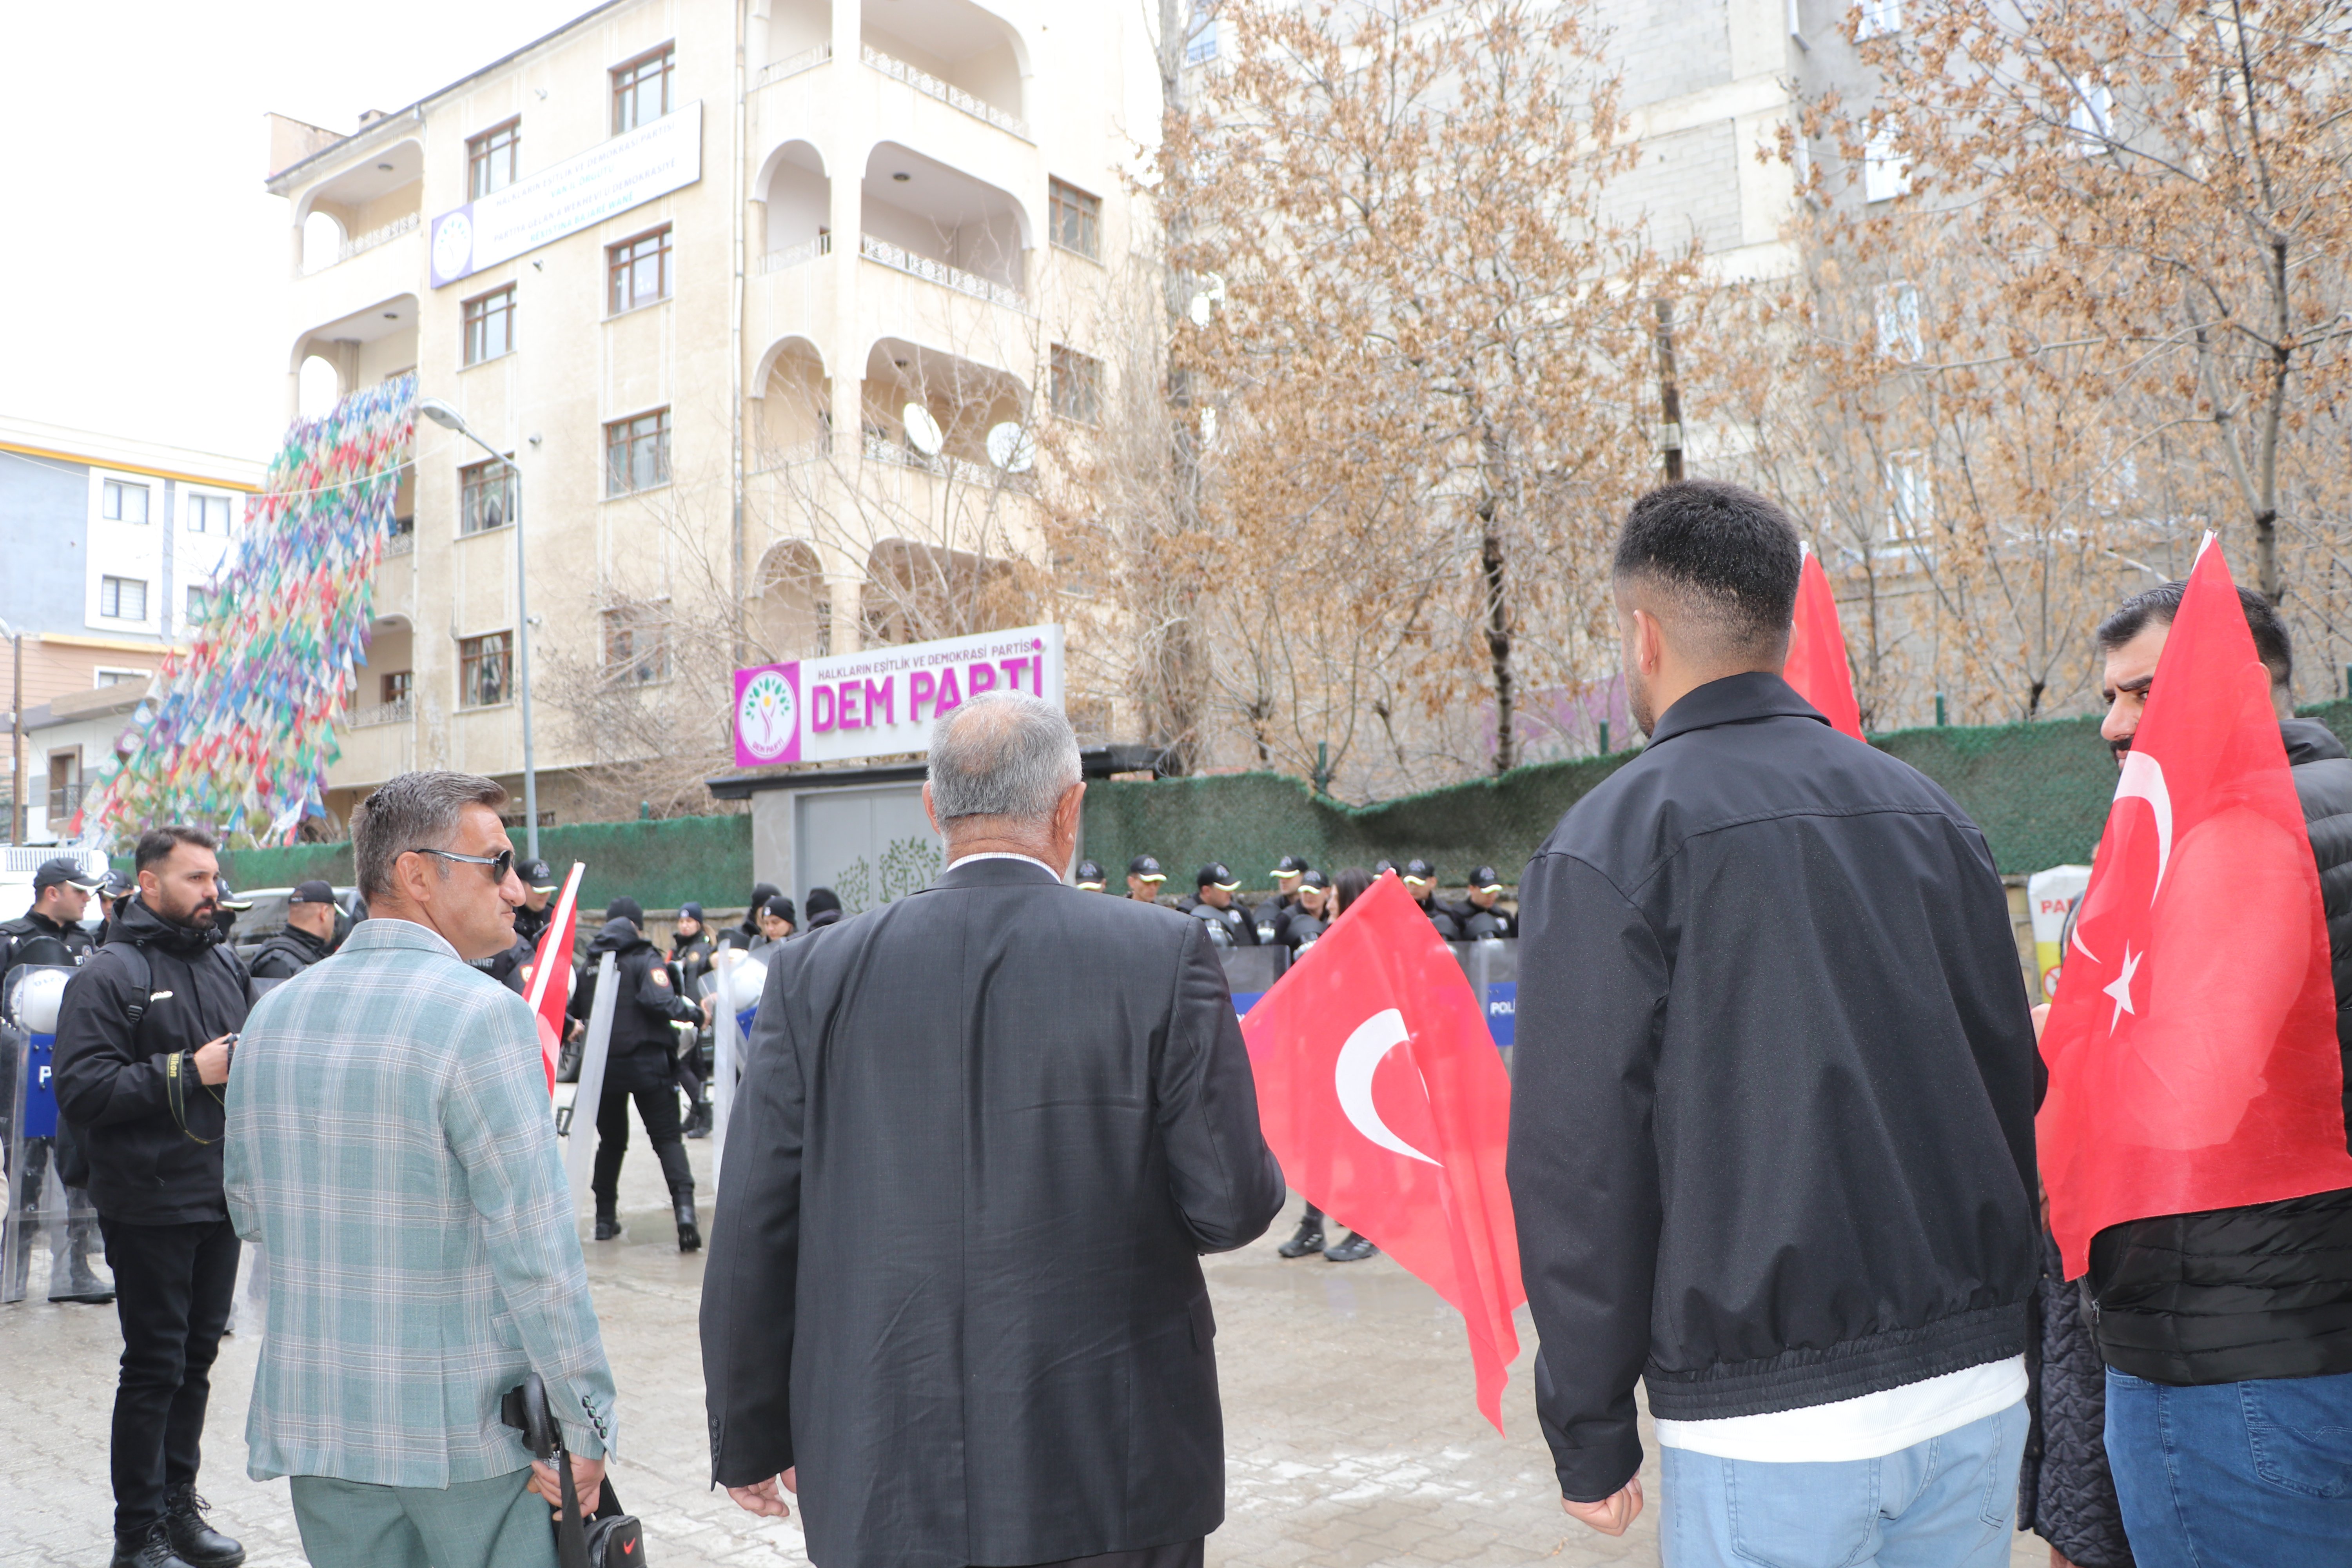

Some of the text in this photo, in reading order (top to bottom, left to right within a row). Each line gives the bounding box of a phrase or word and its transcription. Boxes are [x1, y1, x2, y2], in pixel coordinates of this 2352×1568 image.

[496, 183, 540, 207] HALKLARIN
[575, 162, 584, 172] VE
[551, 185, 567, 198] VAN
[528, 212, 554, 229] GELAN
[557, 208, 561, 217] A
[818, 637, 1033, 680] HALKLARIN EŞİTLİK VE DEMOKRASİ PARTİSİ
[812, 637, 1042, 733] DEM PARTİ
[169, 1053, 180, 1078] Nikon
